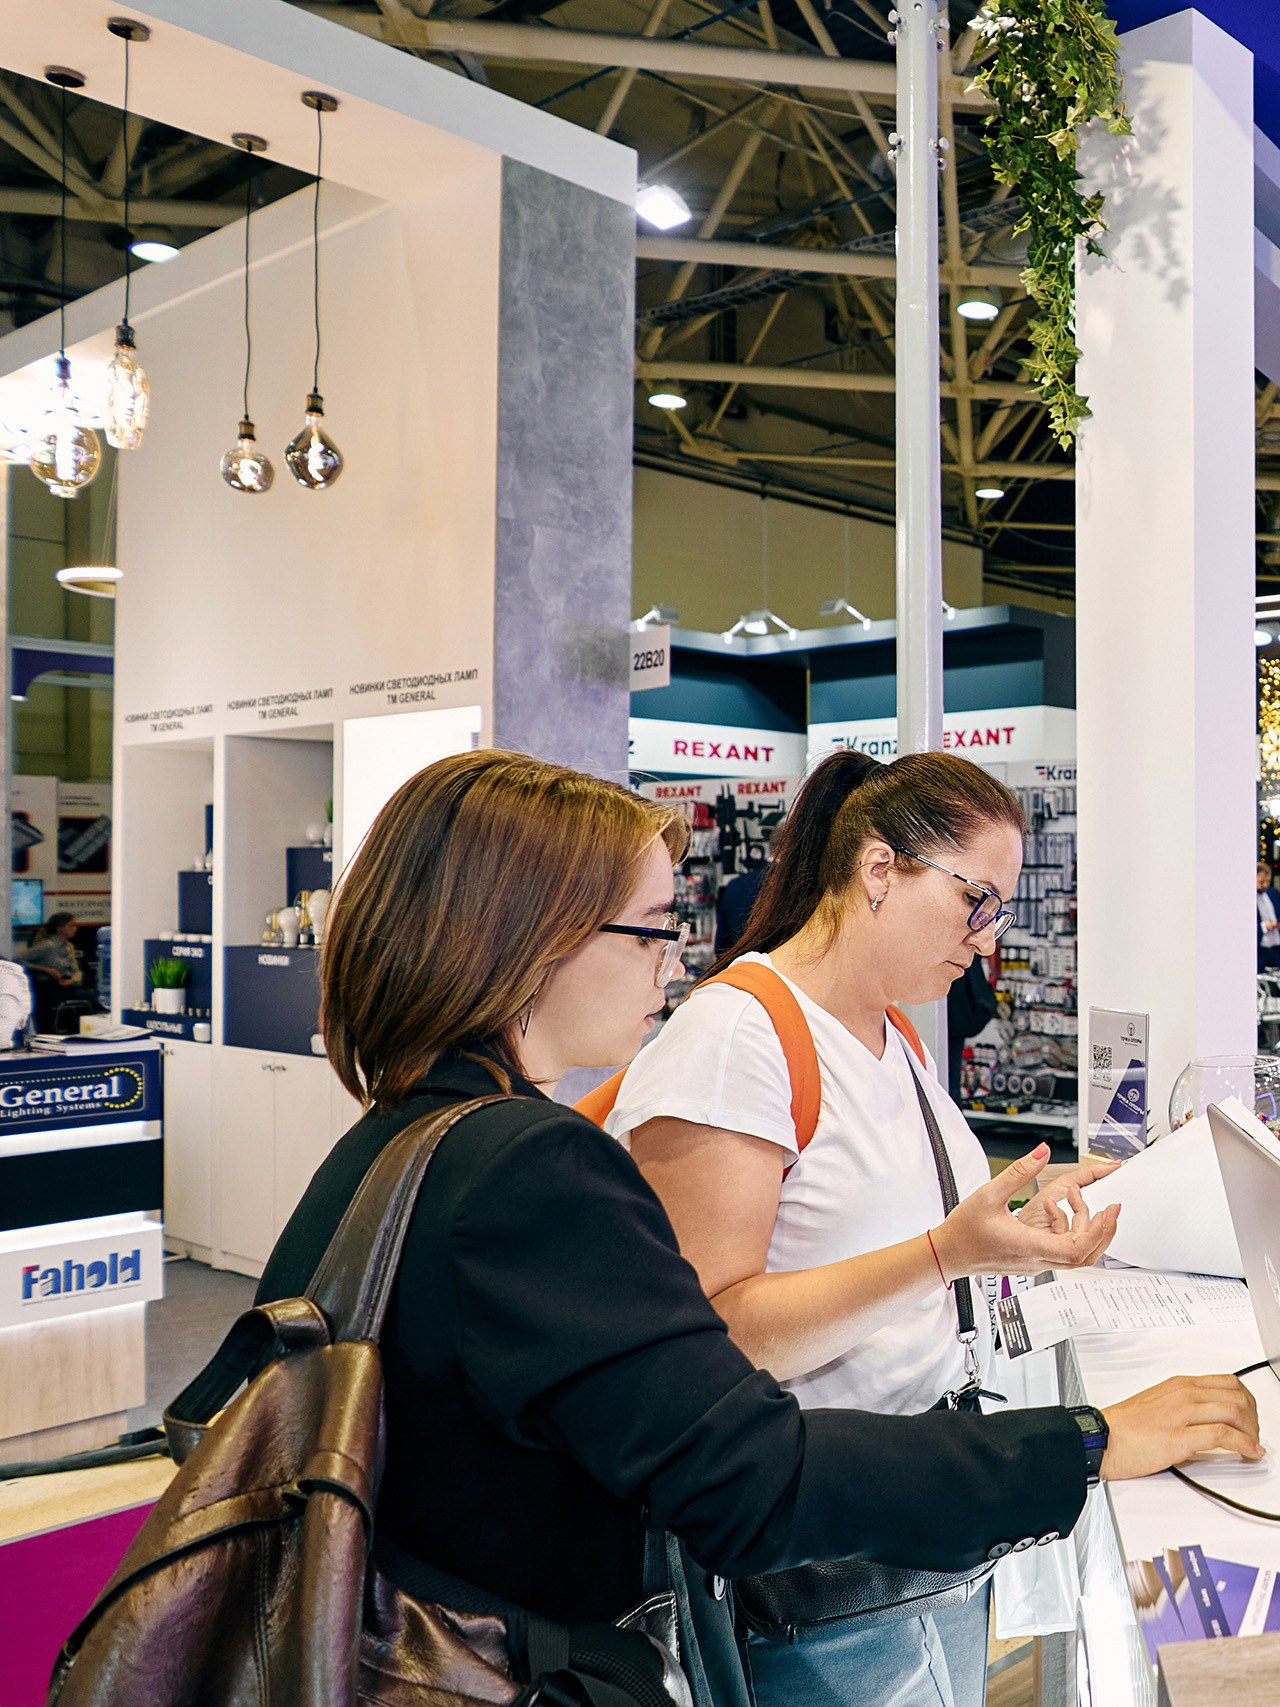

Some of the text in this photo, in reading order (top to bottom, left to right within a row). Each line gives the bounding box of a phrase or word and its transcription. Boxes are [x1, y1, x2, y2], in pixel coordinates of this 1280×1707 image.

[633, 649, 665, 671] 22B20
[349, 668, 478, 695] НОВИНКИ СВЕТОДИОДНЫХ ЛАМП
[227, 688, 333, 711] НОВИНКИ СВЕТОДИОДНЫХ ЛАМП
[398, 690, 436, 704] GENERAL
[268, 706, 299, 719] GENERAL
[943, 727, 1015, 748] EXANT
[674, 740, 774, 763] REXANT
[655, 785, 702, 799] REXANT
[737, 781, 787, 795] REXANT
[0, 1075, 121, 1108] General
[0, 1102, 102, 1118] Lighting Systems
[22, 1249, 141, 1300] Fahold
